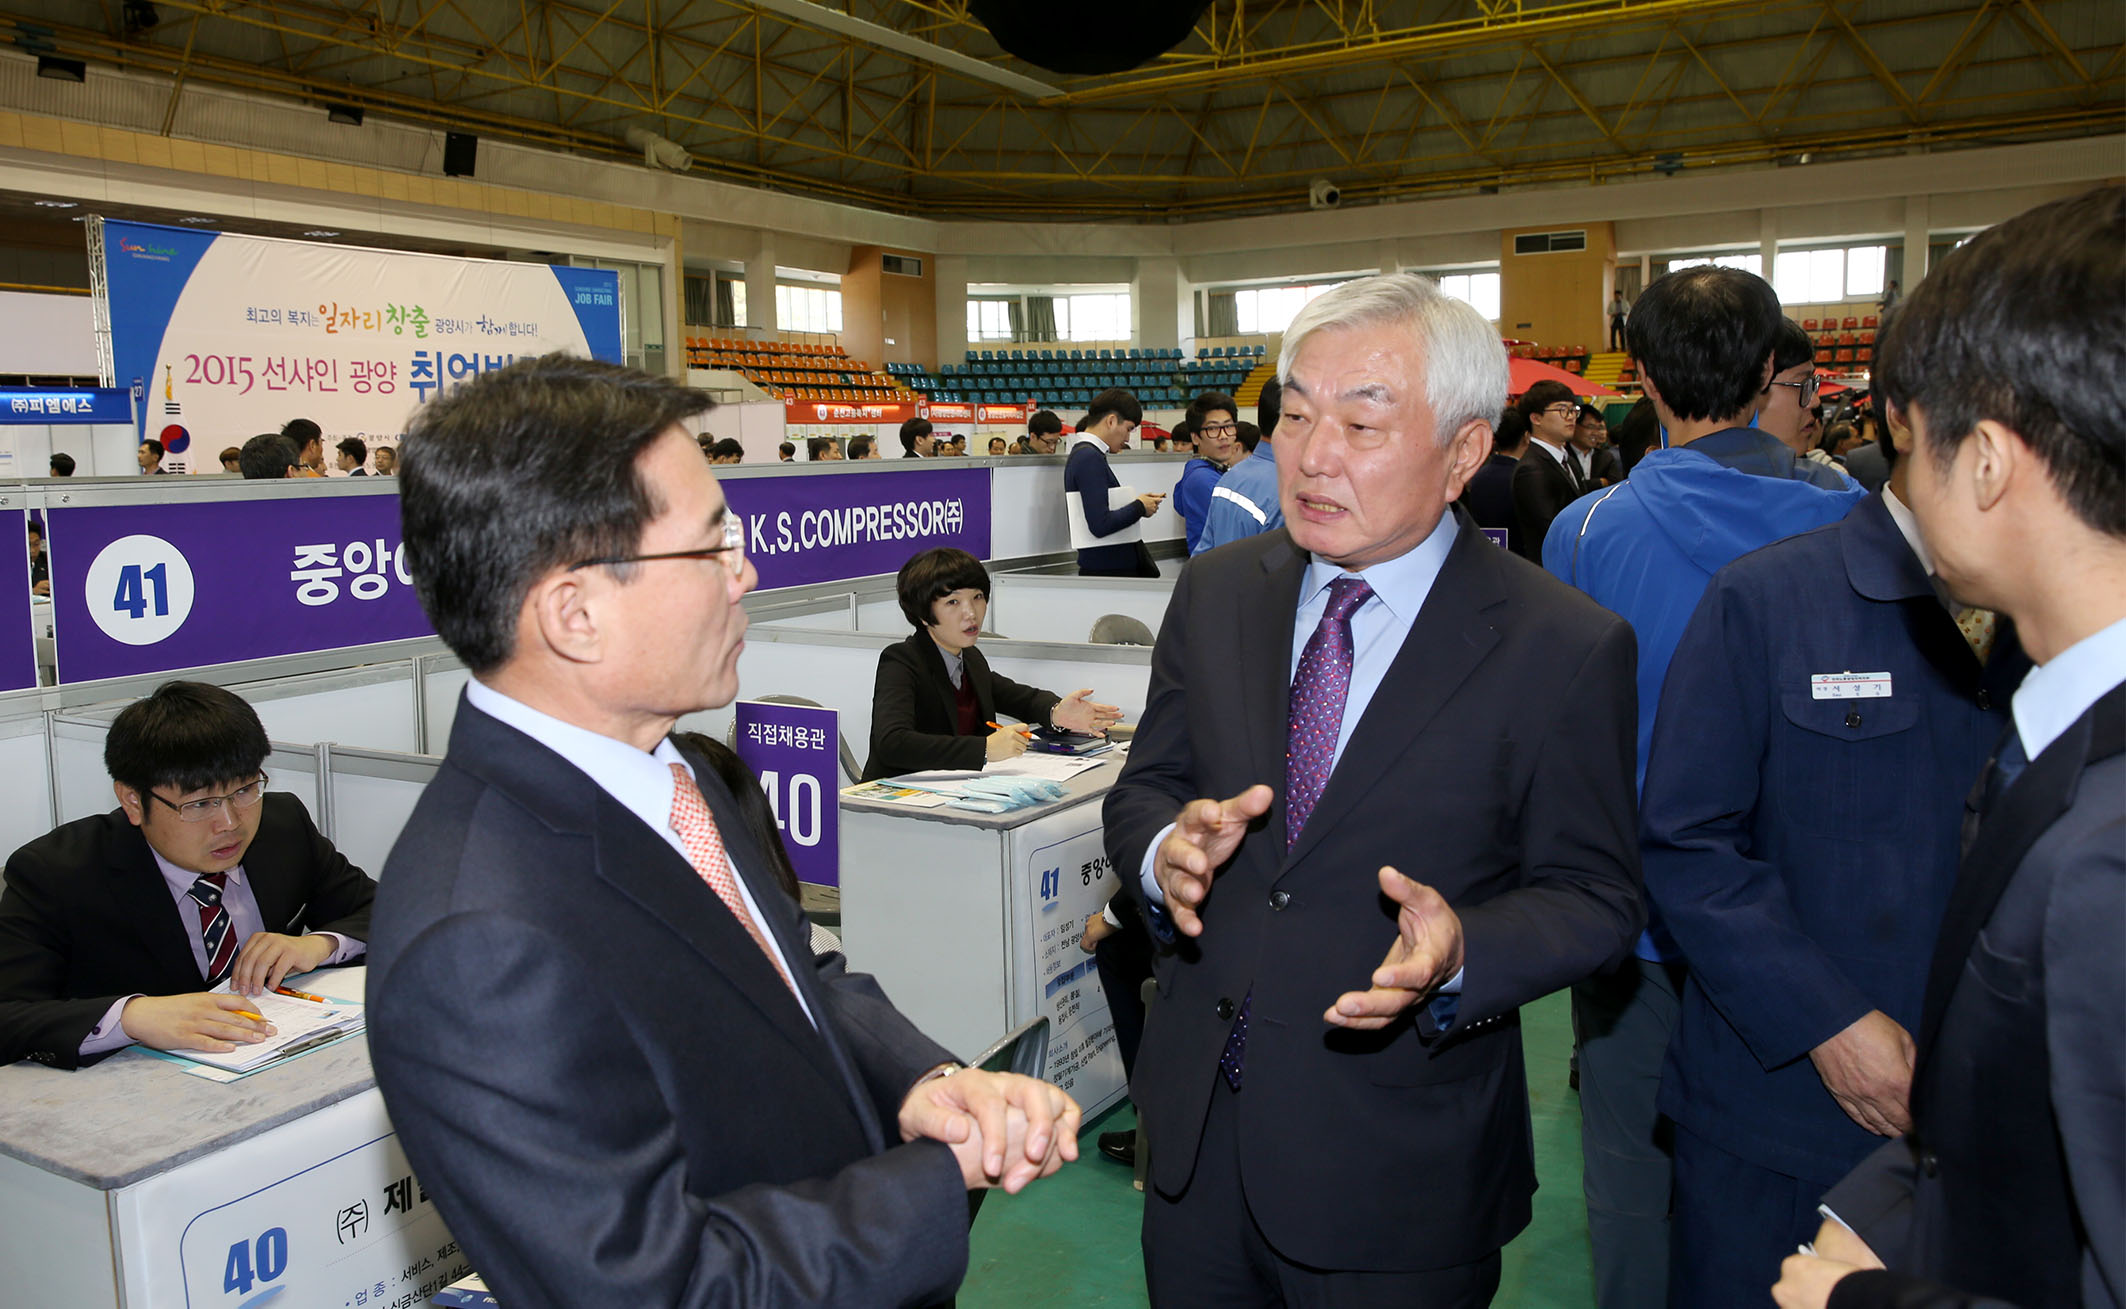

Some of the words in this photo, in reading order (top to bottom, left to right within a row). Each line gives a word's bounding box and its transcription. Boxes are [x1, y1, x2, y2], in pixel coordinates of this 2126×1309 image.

[575, 292, 592, 305] JOB
[593, 294, 613, 306] FAIR
[246, 306, 282, 325] 최고의
[287, 309, 320, 327] 복지는
[319, 301, 382, 334] 일자리
[385, 302, 430, 339] 창출
[435, 318, 473, 335] 광양시가
[184, 353, 255, 396] 2015
[261, 356, 339, 393] 선샤인
[349, 359, 397, 394] 광양
[113, 562, 169, 620] 41
[748, 722, 825, 751] 직접채용관
[1040, 866, 1060, 901] 41
[224, 1226, 288, 1296] 40
[355, 1289, 367, 1306] 업
[373, 1281, 386, 1298] 종
[401, 1257, 434, 1282] 서비스,
